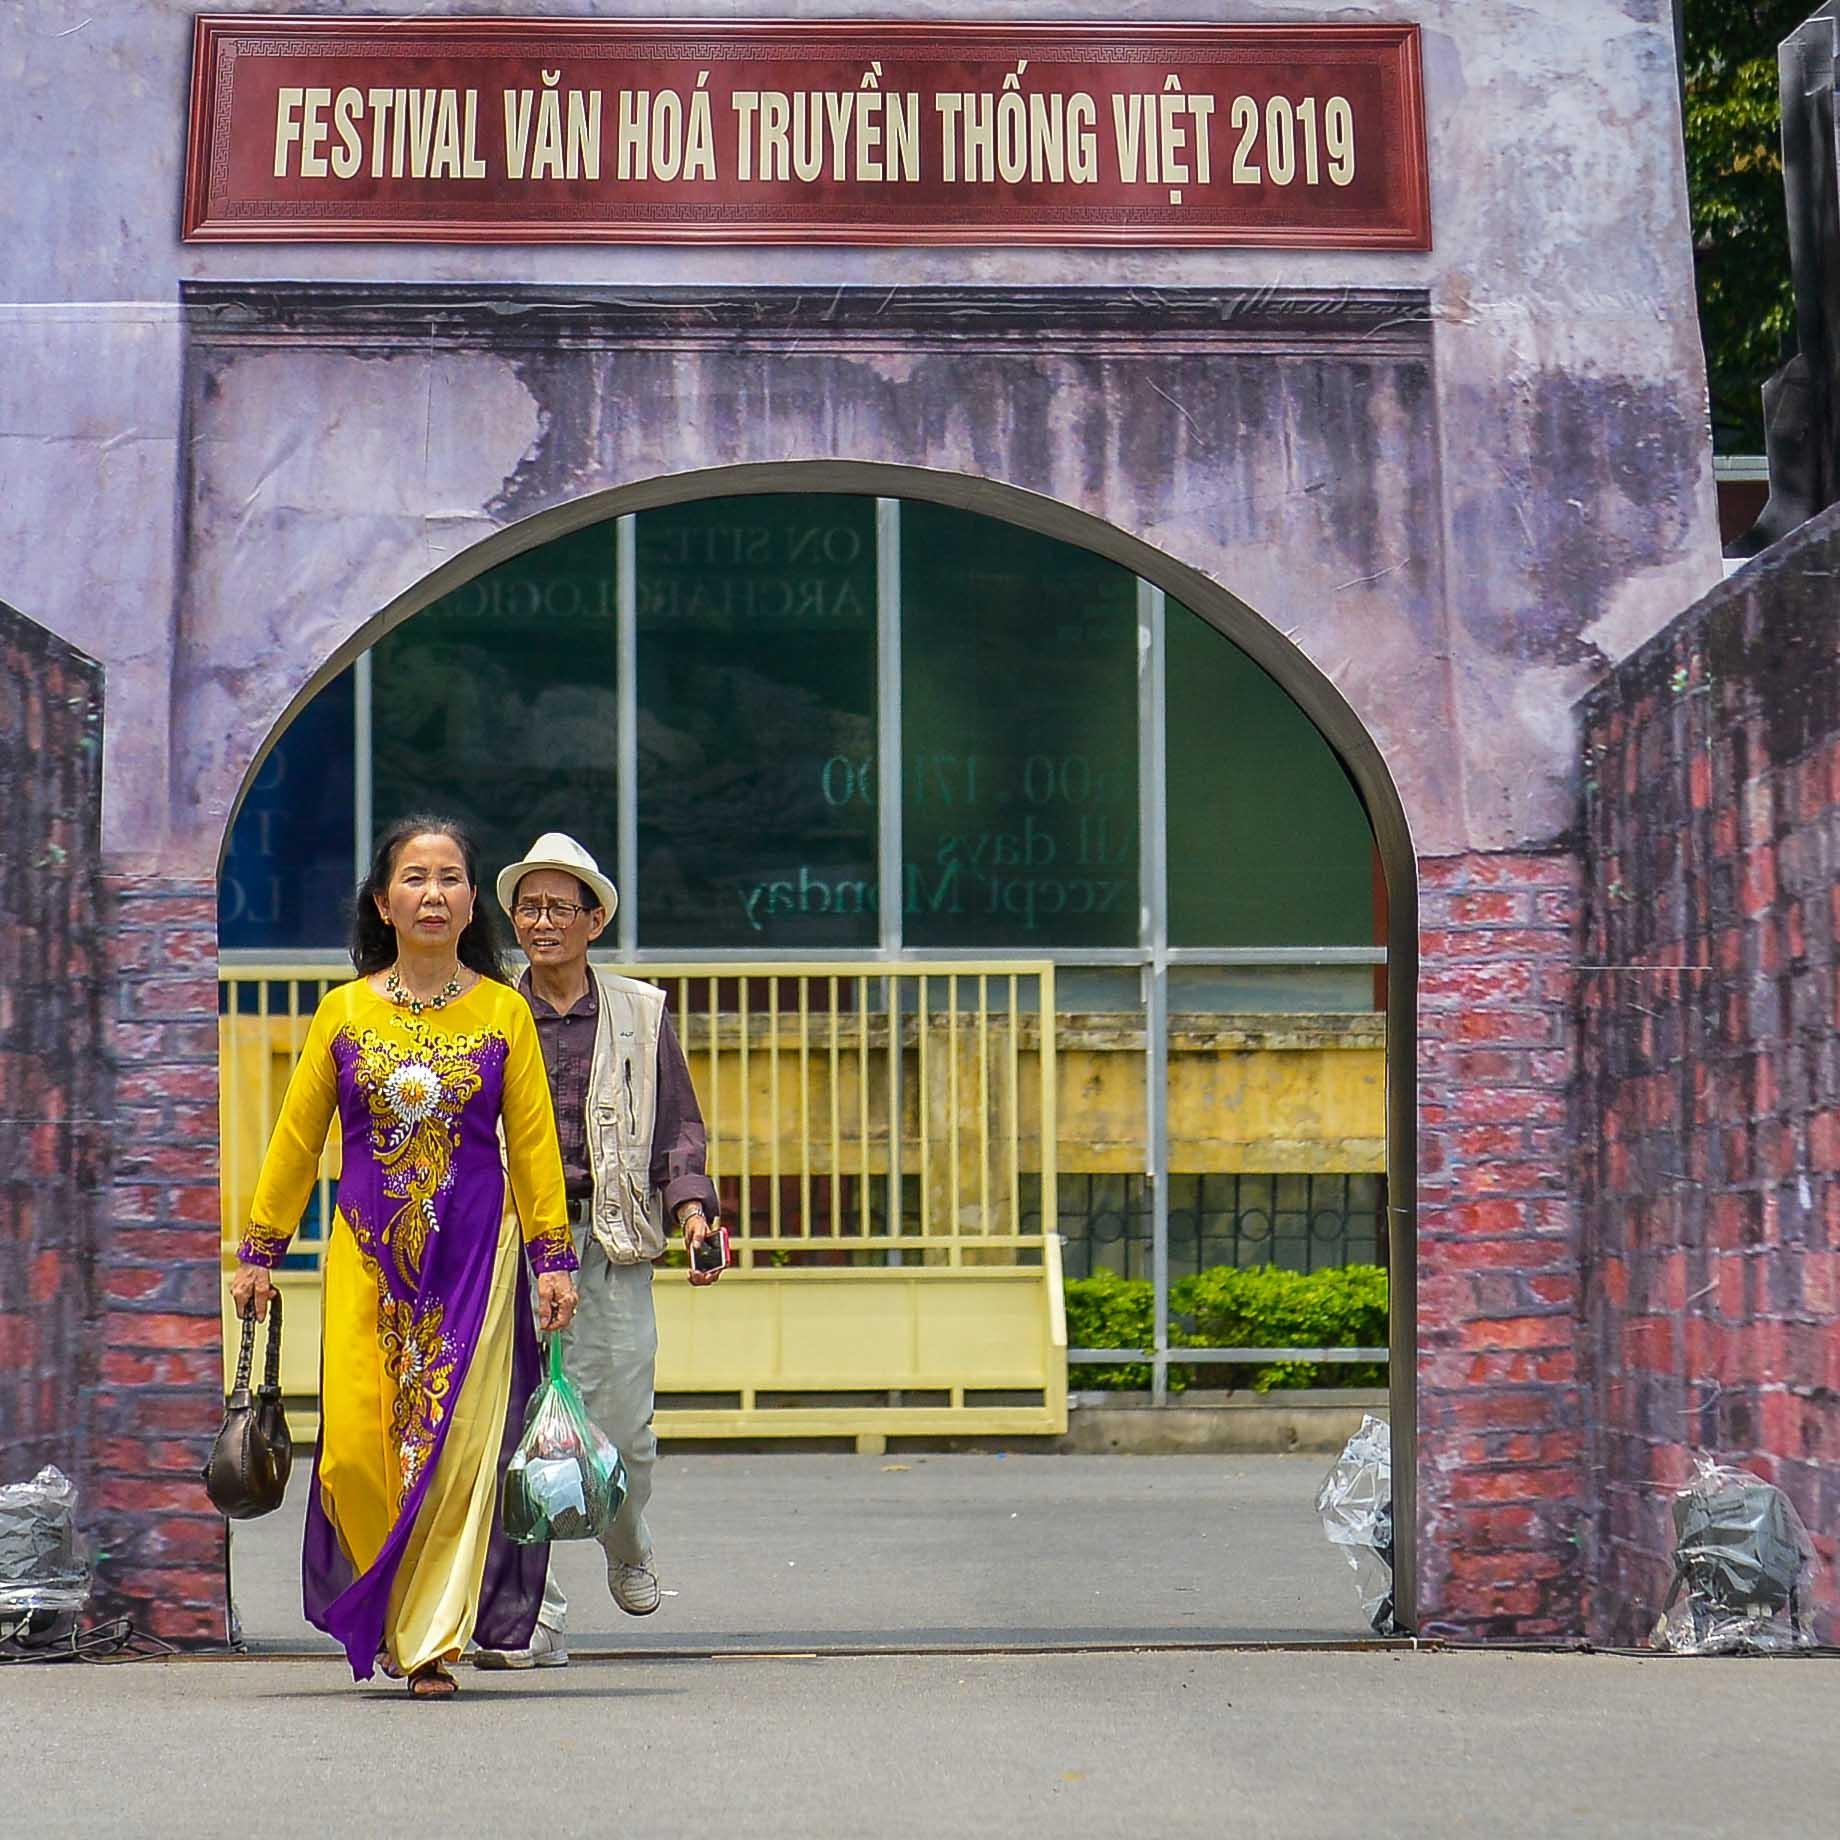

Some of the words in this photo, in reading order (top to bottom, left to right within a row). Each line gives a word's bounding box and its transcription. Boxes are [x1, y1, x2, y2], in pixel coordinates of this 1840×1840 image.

[271, 86, 487, 181] FESTIVAL
[503, 68, 602, 181] VĂN
[617, 71, 714, 183] HOÁ
[731, 60, 919, 184] TRUYỀN
[935, 61, 1098, 185] THỐNG
[1110, 73, 1216, 207] VIỆT
[1230, 94, 1357, 188] 2019
